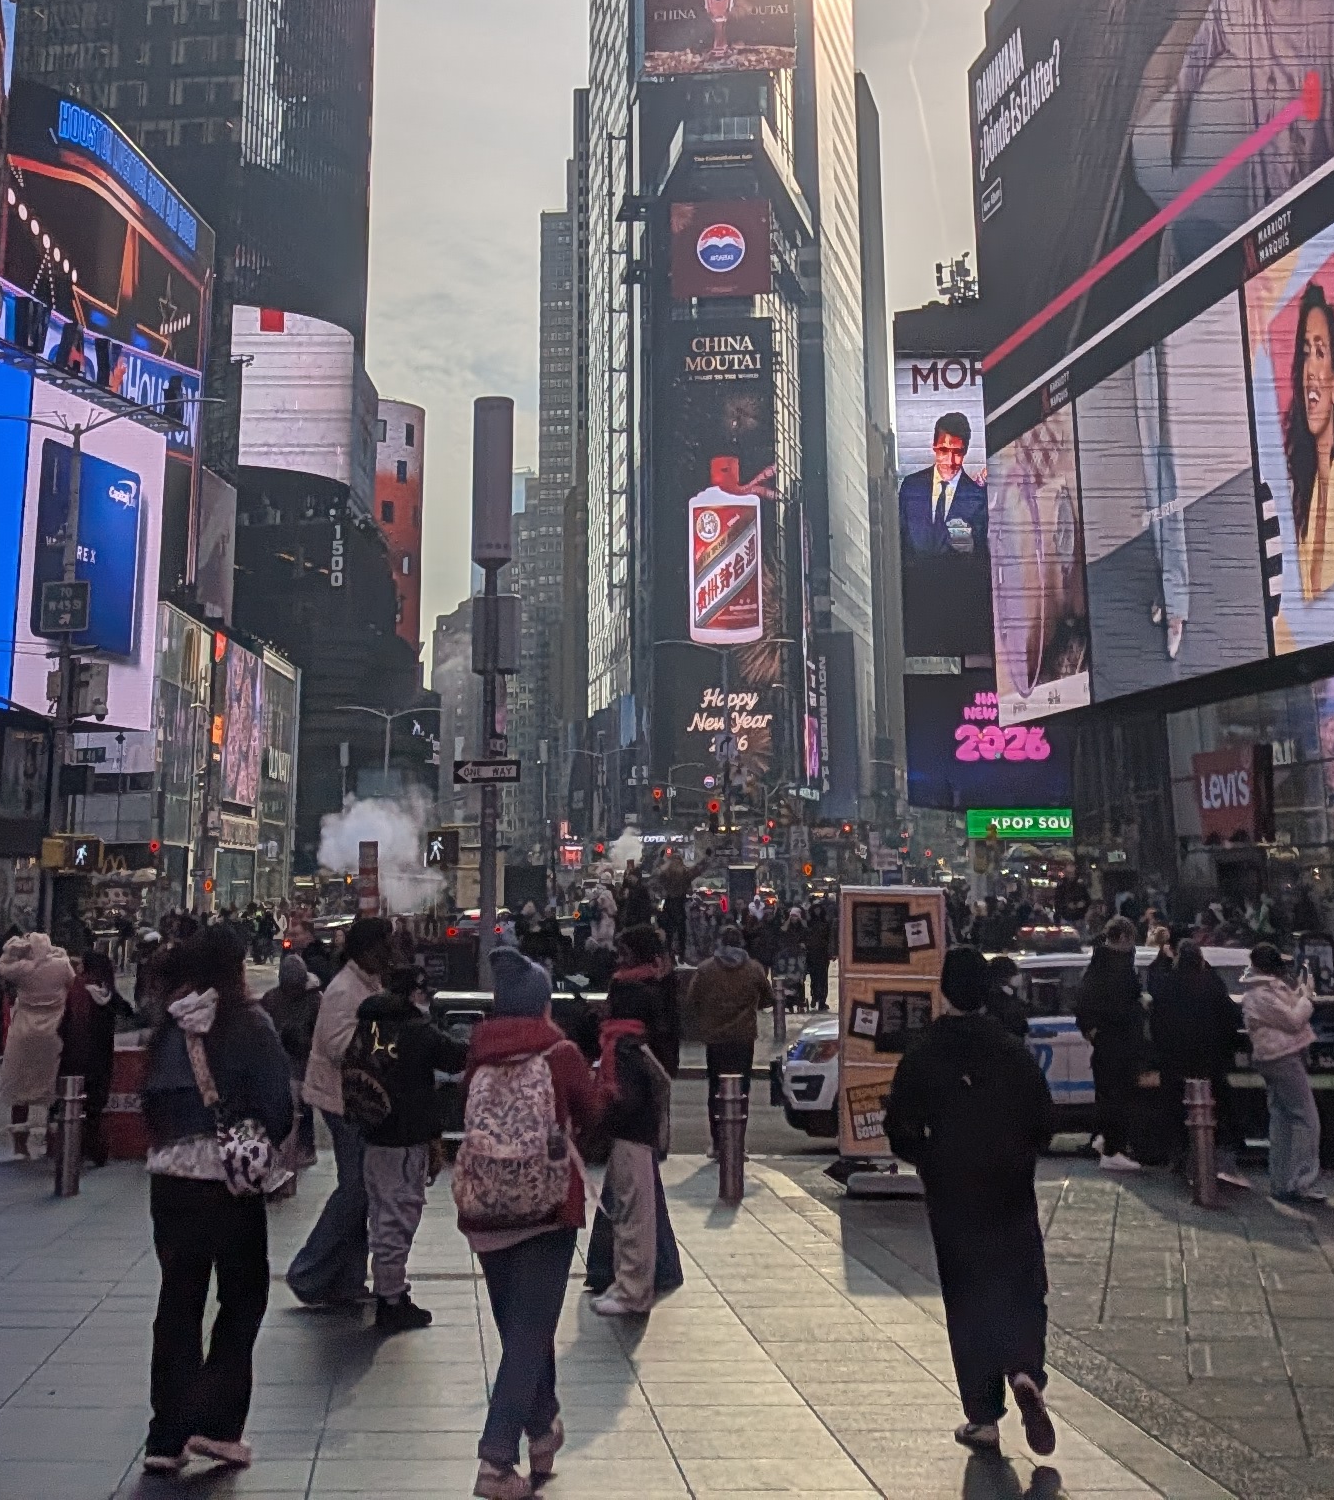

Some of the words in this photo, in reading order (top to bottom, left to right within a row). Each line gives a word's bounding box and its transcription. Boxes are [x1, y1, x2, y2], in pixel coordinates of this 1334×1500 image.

[976, 27, 1024, 124] RAWAYANA
[1010, 91, 1021, 137] Es
[1021, 74, 1031, 126] El
[1031, 38, 1060, 115] After?
[1258, 210, 1292, 245] MARRIOTT
[1259, 232, 1290, 263] MARQUIS
[691, 335, 754, 353] CHINA
[685, 353, 762, 372] MOUTAI
[331, 525, 343, 586] 1500
[731, 711, 774, 734] Year
[819, 656, 829, 762] NOVEMBER
[964, 707, 998, 720] NEW
[955, 724, 1050, 762] 2026
[464, 768, 480, 777] ONE
[492, 767, 512, 777] WAY
[991, 816, 1033, 830] KPOP
